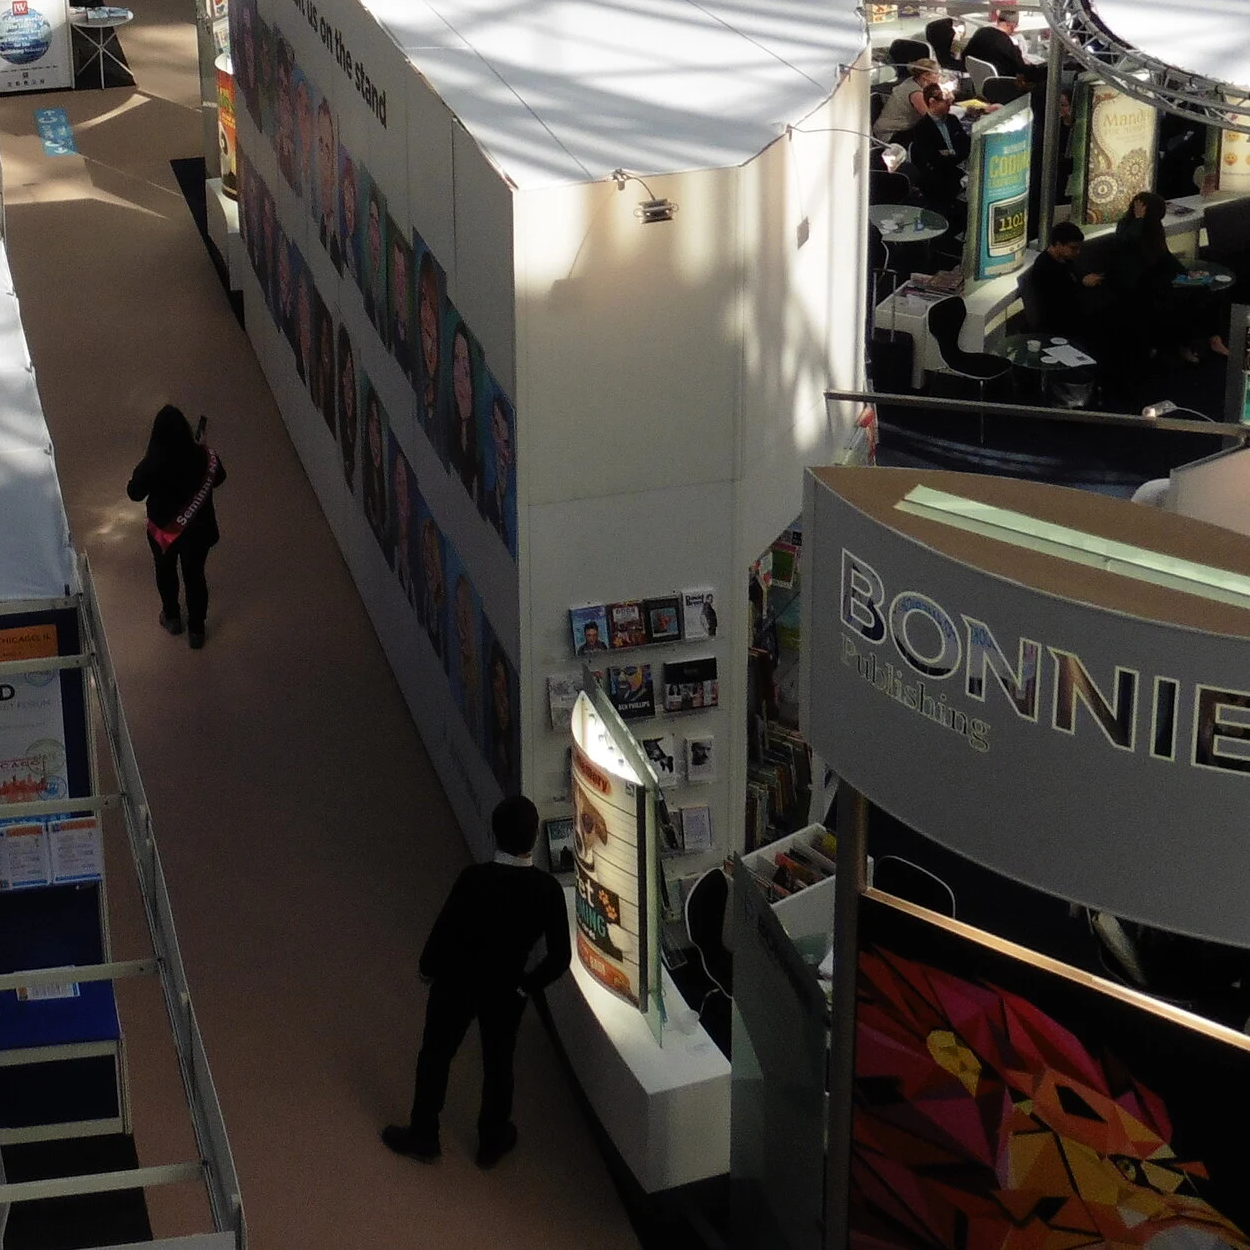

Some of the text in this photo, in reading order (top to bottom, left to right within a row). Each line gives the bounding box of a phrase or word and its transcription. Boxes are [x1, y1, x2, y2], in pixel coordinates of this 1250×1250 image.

[306, 2, 319, 34] us
[320, 15, 333, 54] on
[335, 27, 353, 81] the
[354, 61, 388, 130] stand
[176, 477, 213, 526] Seminar
[685, 594, 704, 603] David
[17, 700, 50, 709] FORUM
[618, 701, 651, 711] BEN PHILLIPS
[841, 632, 991, 753] Publishing
